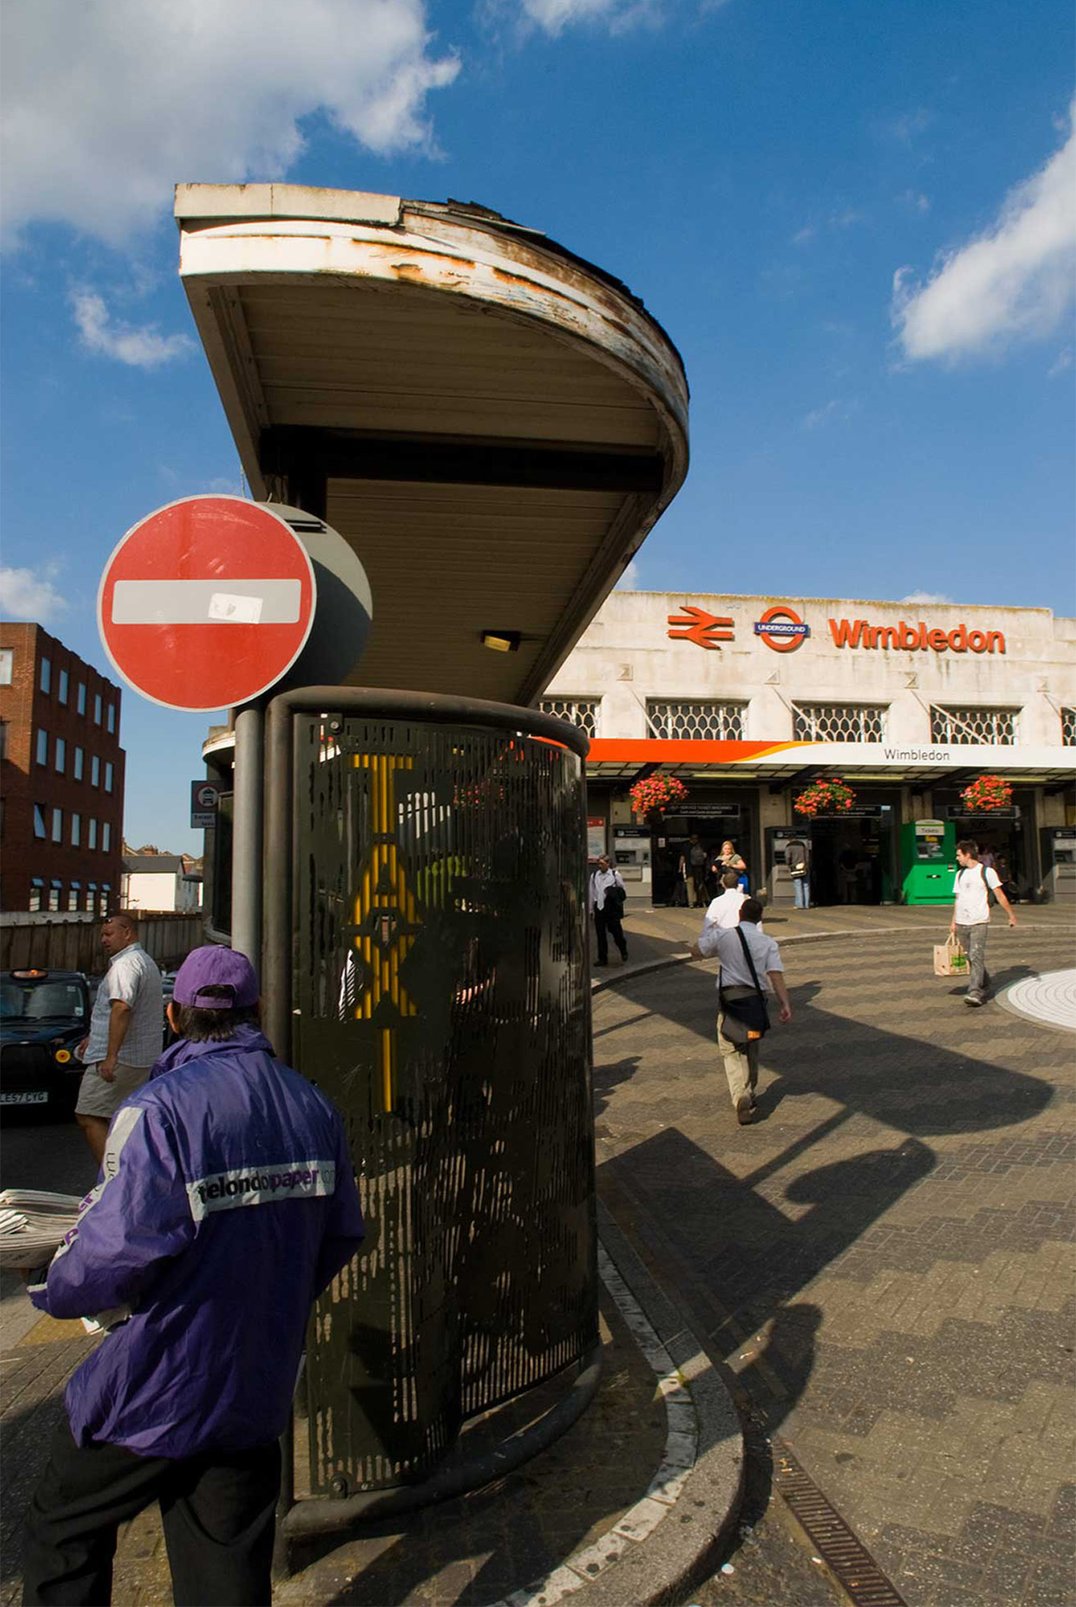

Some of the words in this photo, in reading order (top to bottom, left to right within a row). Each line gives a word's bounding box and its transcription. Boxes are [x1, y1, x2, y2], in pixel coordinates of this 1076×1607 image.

[757, 624, 806, 633] UNDERGROUND
[828, 619, 1005, 654] Wimbledon
[884, 748, 950, 761] Wimbledon
